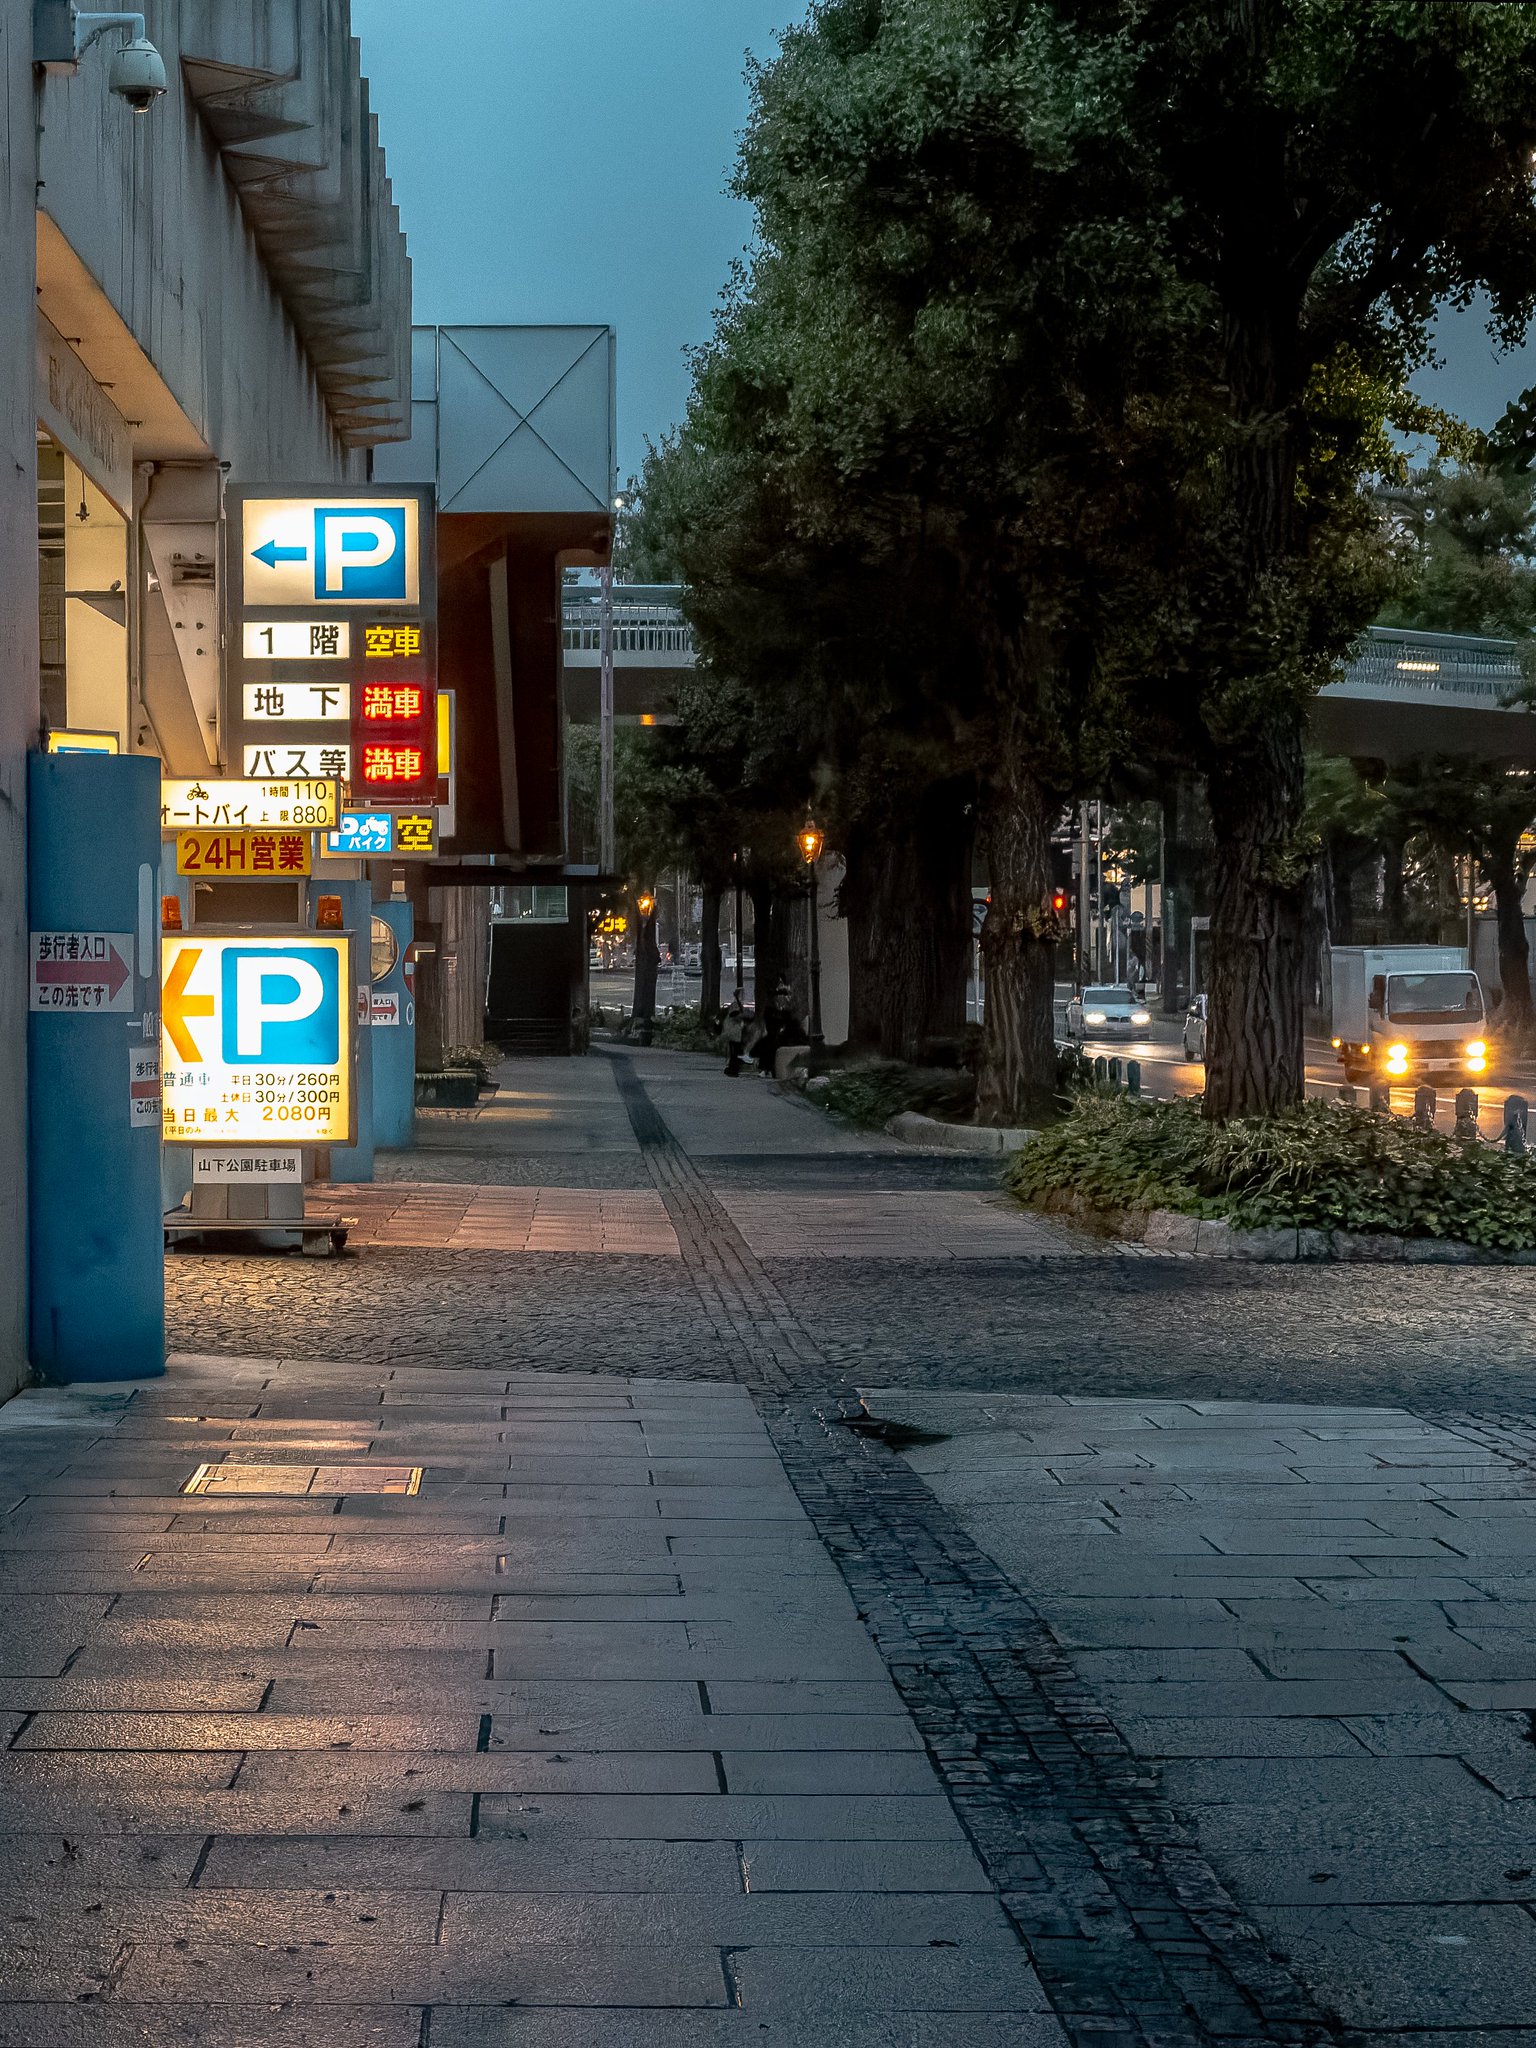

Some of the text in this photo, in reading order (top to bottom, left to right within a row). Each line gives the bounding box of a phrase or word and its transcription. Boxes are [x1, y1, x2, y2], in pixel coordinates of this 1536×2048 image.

[325, 516, 396, 591] P
[365, 626, 421, 657] 空車
[254, 687, 340, 716] 地下
[365, 687, 420, 718] 満車
[249, 749, 346, 777] バス等
[365, 748, 421, 779] 満車
[330, 817, 359, 847] P
[348, 836, 386, 850] バイク
[397, 814, 433, 851] 空
[184, 836, 304, 870] 24H営業
[39, 936, 105, 960] 歩行者入口
[38, 986, 104, 1007] この先です
[237, 957, 323, 1056] P
[198, 1158, 296, 1172] 山下公園駐車場
